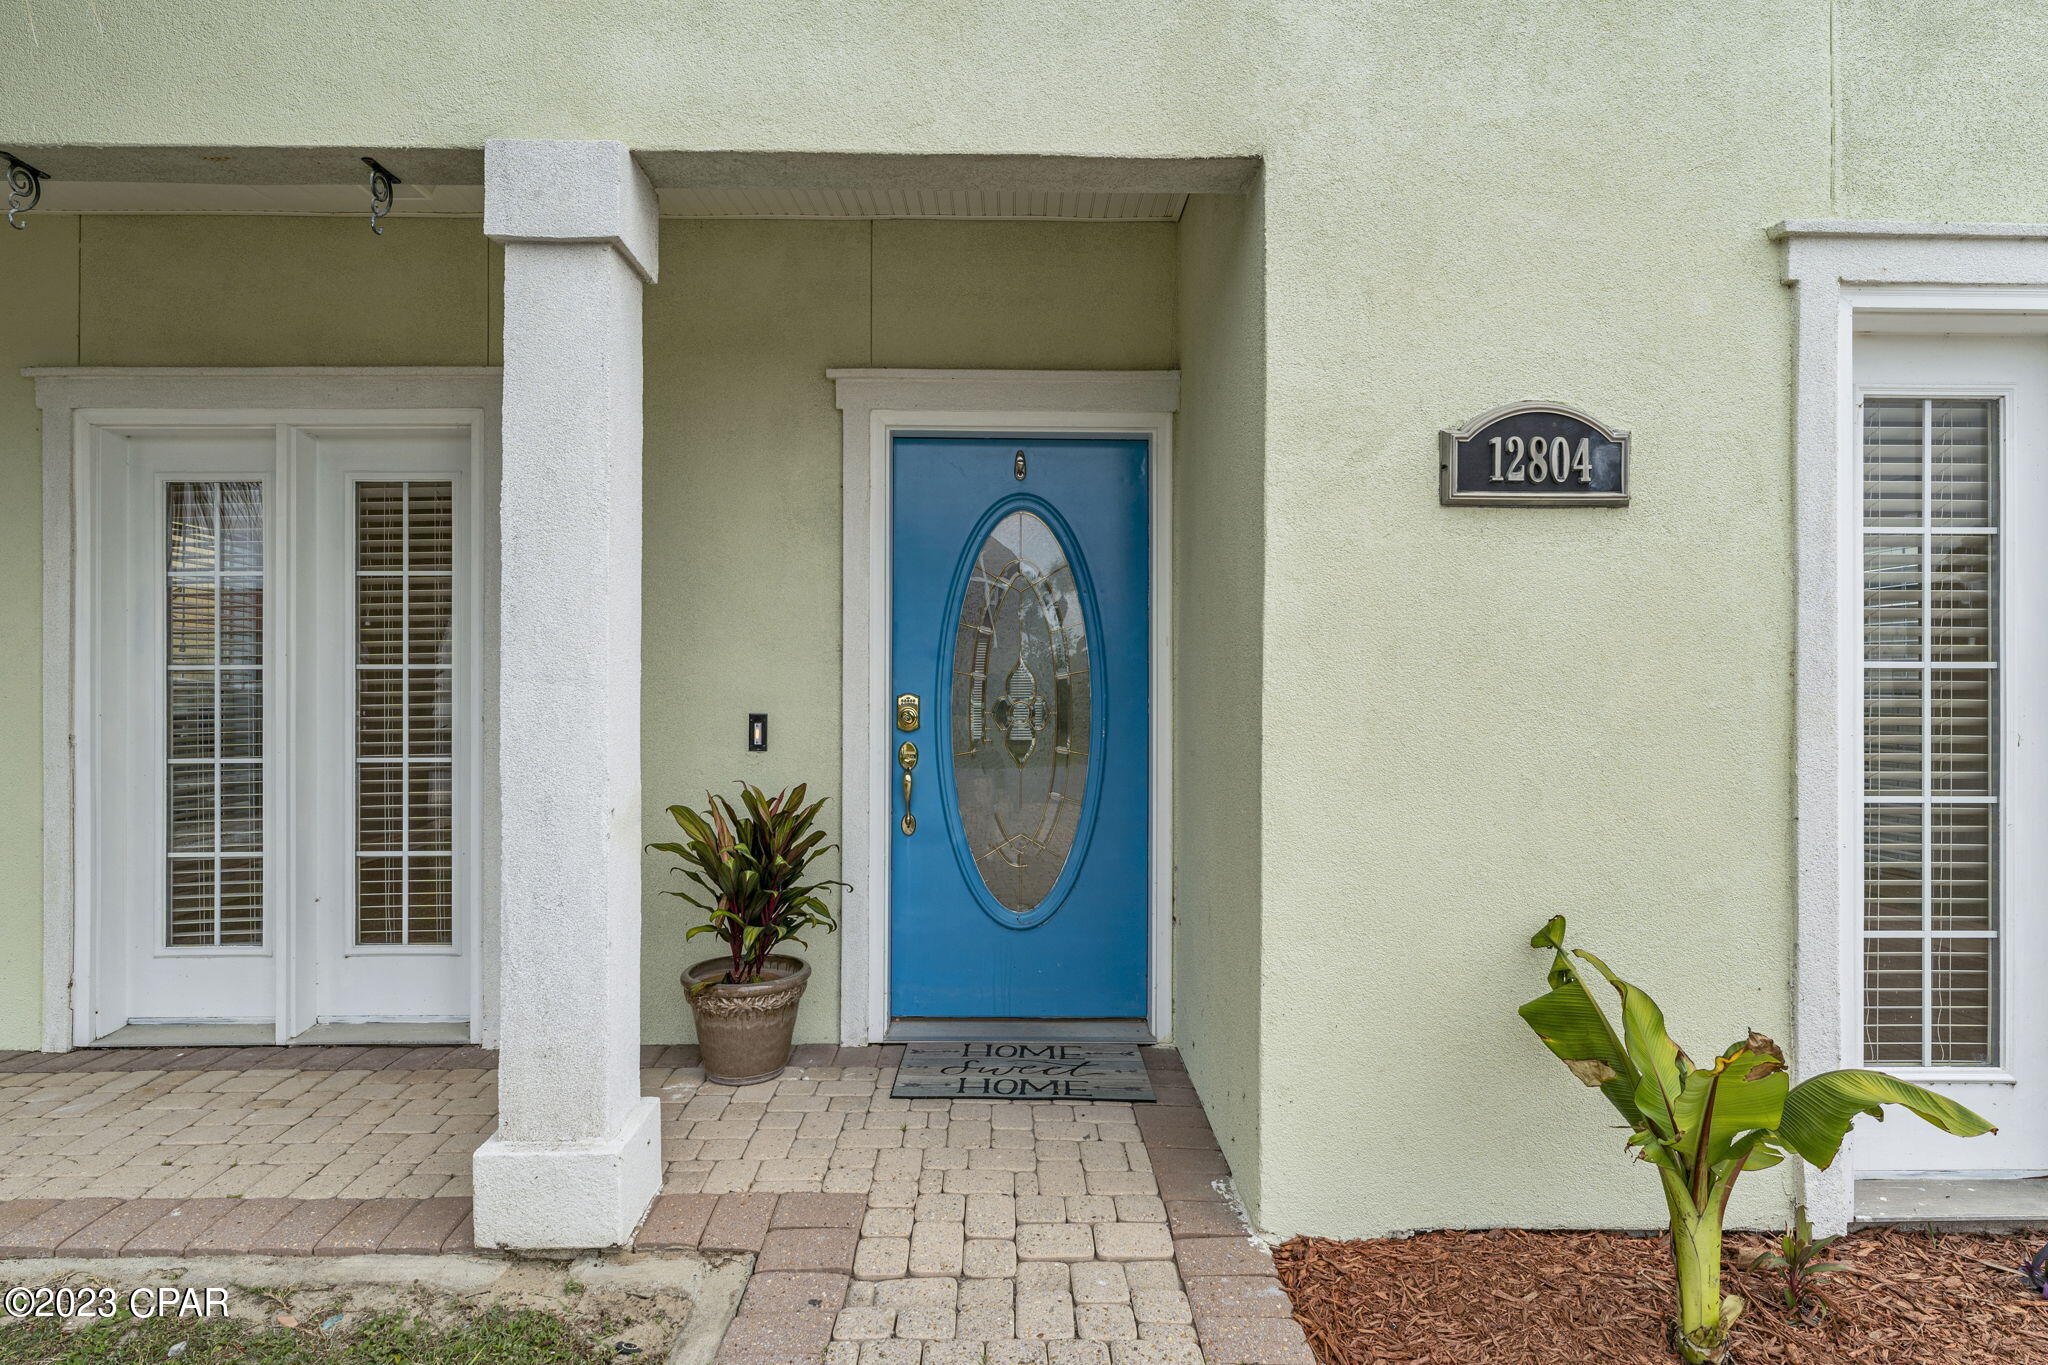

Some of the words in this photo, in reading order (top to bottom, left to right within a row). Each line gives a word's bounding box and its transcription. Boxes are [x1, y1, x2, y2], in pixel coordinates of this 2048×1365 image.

[1488, 435, 1593, 483] 12804
[961, 1043, 1086, 1060] HOME
[956, 1077, 1093, 1097] HOME
